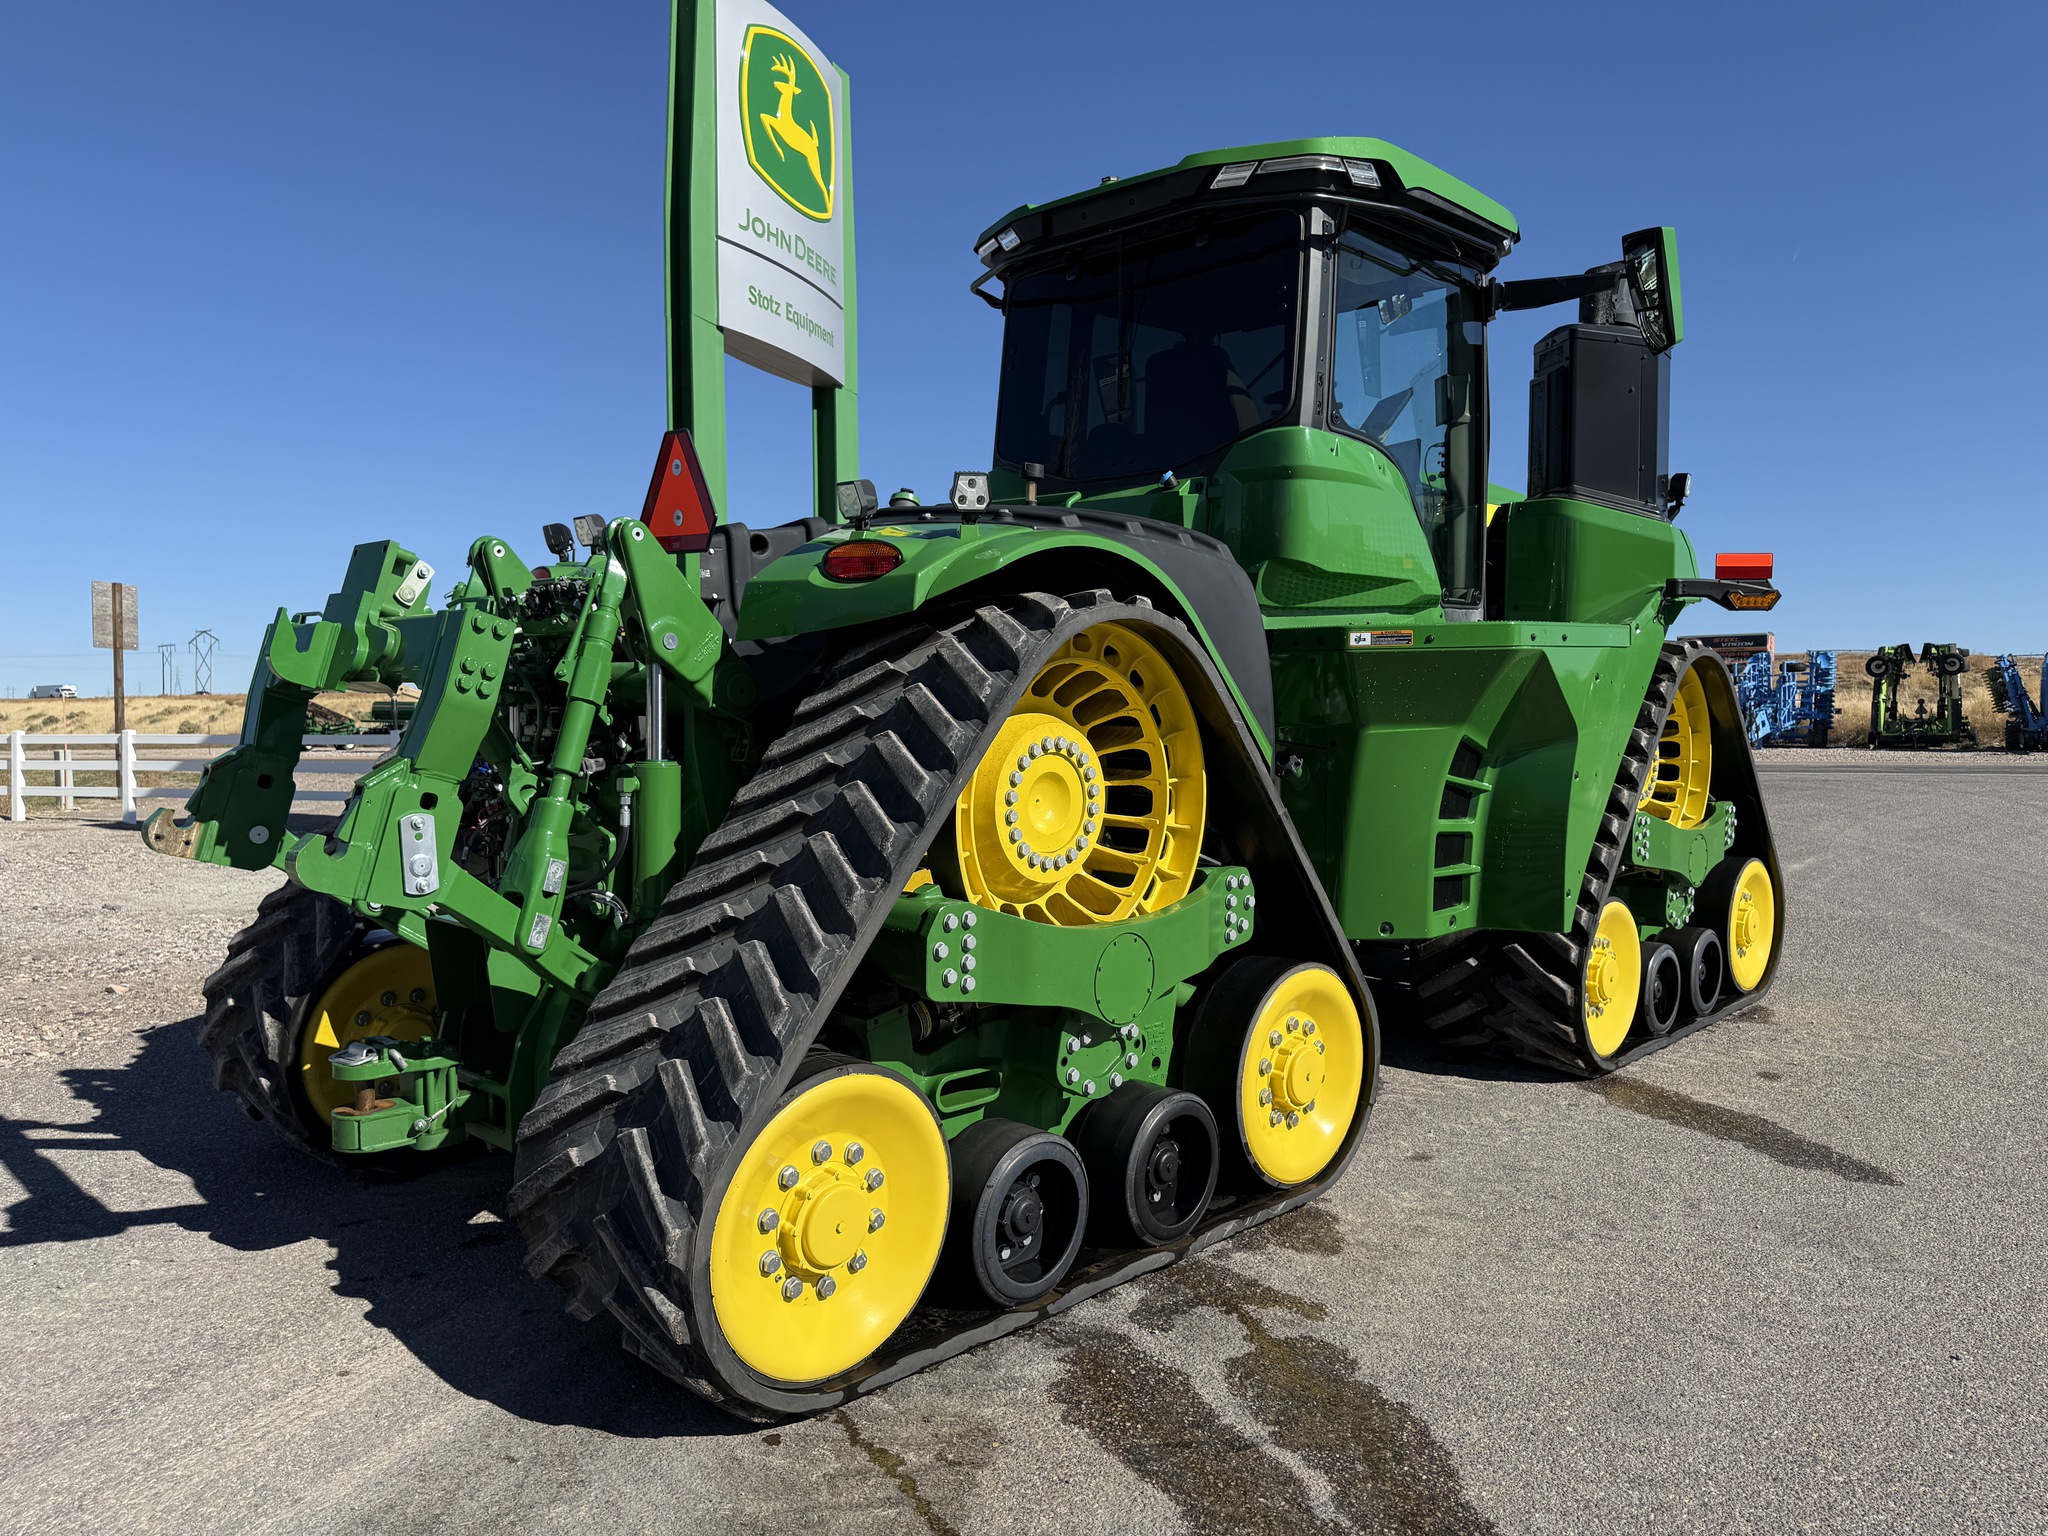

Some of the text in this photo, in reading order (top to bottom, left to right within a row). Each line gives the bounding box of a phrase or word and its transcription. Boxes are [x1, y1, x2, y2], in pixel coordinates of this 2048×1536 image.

[738, 208, 837, 287] JOHN DEERE
[748, 285, 835, 348] Stotz Equipment
